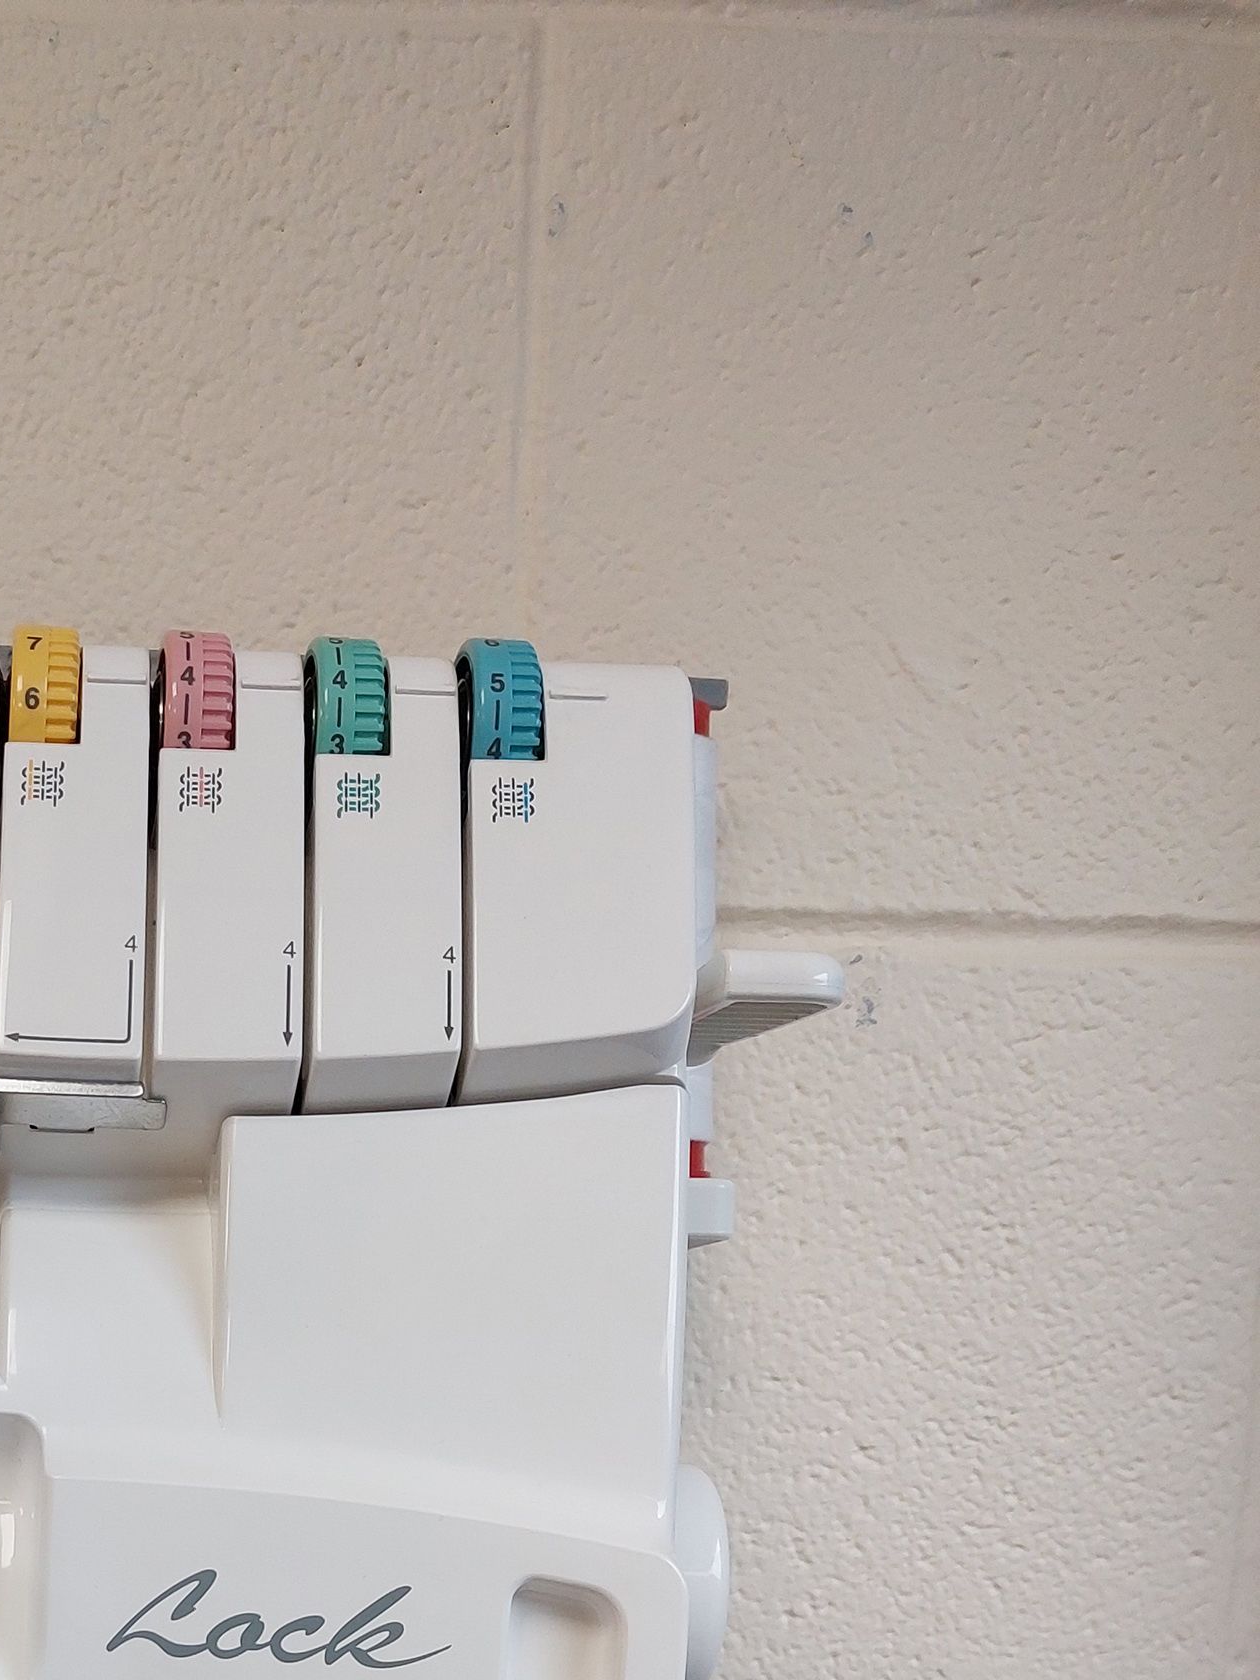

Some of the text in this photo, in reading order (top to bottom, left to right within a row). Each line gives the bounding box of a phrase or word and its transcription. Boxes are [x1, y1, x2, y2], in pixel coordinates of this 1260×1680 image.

[26, 636, 43, 650] 7
[180, 666, 195, 686] 4
[332, 669, 347, 690] 4
[490, 672, 506, 693] 5
[24, 686, 41, 710] 6
[177, 731, 192, 748] 3
[330, 734, 345, 754] 3
[486, 737, 502, 760] 4
[124, 935, 138, 953] 4
[281, 941, 297, 959] 4
[442, 946, 457, 964] 4
[106, 1568, 452, 1669] Lock
